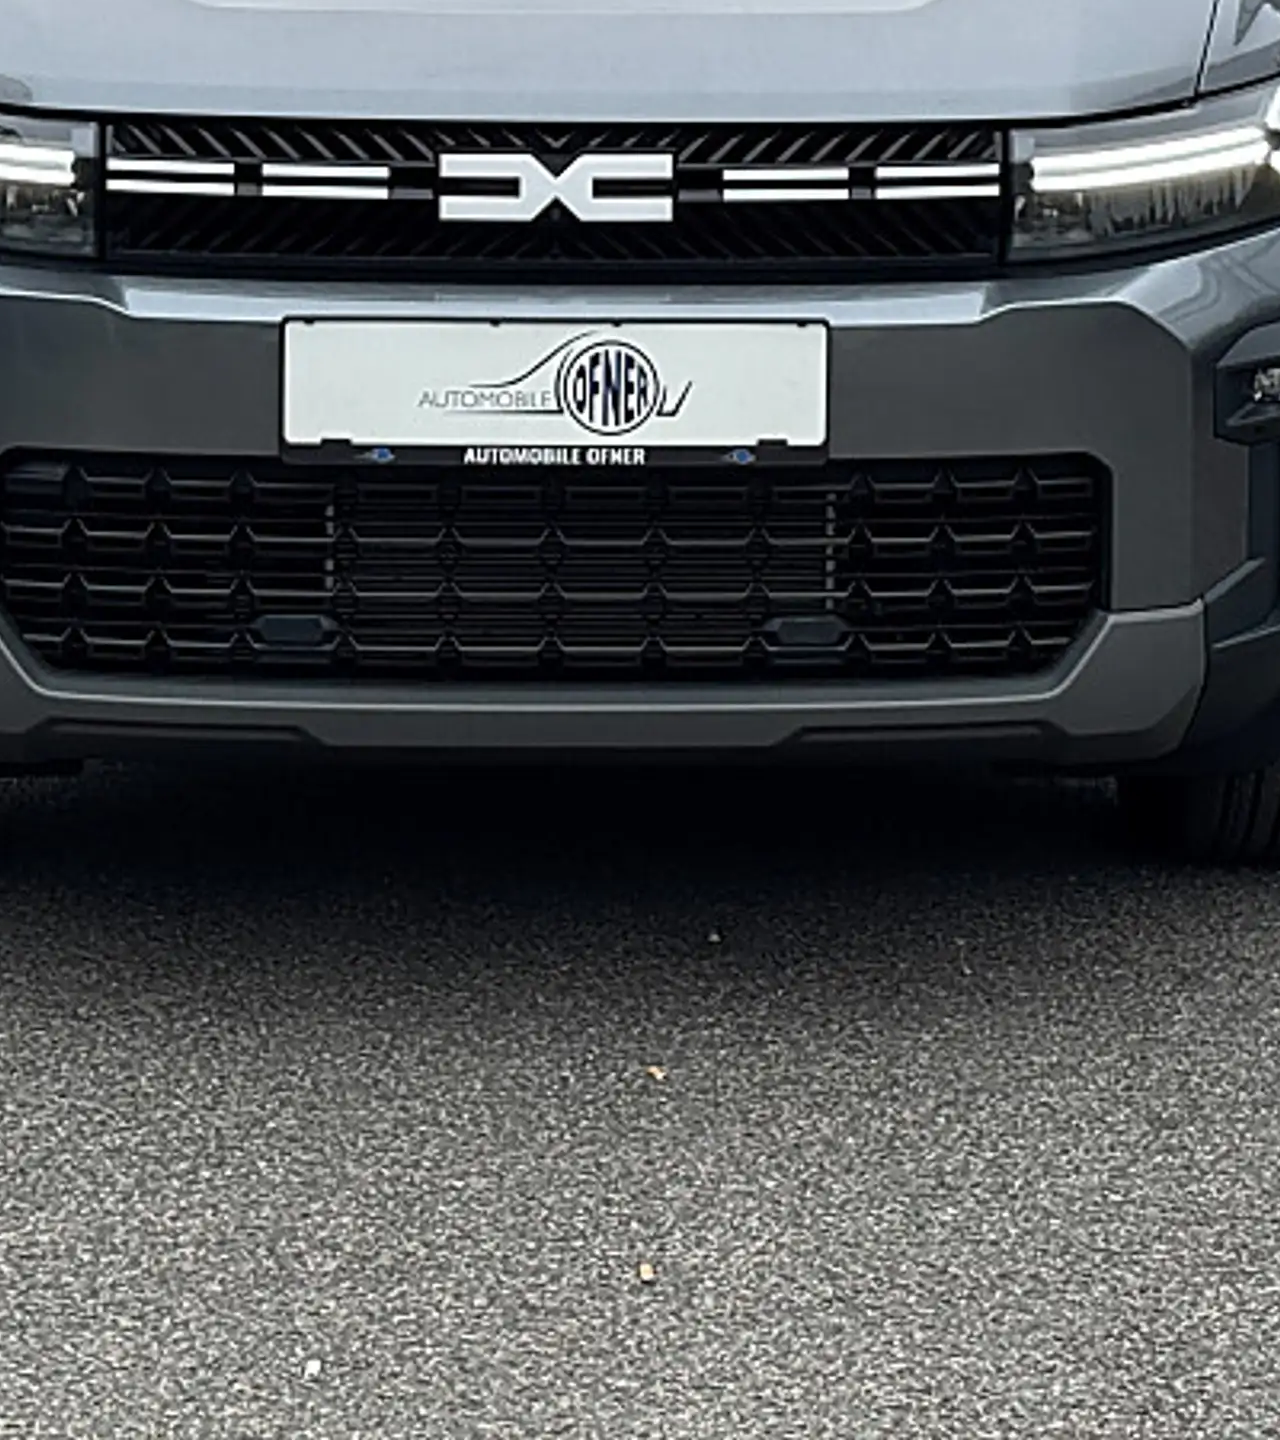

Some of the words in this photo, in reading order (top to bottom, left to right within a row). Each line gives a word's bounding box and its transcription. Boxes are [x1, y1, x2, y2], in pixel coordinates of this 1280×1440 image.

[416, 390, 553, 408] AUTOMOBILE
[572, 348, 649, 427] OFNER
[463, 447, 582, 465] AUTOMOBILE
[586, 447, 646, 465] OFNER
